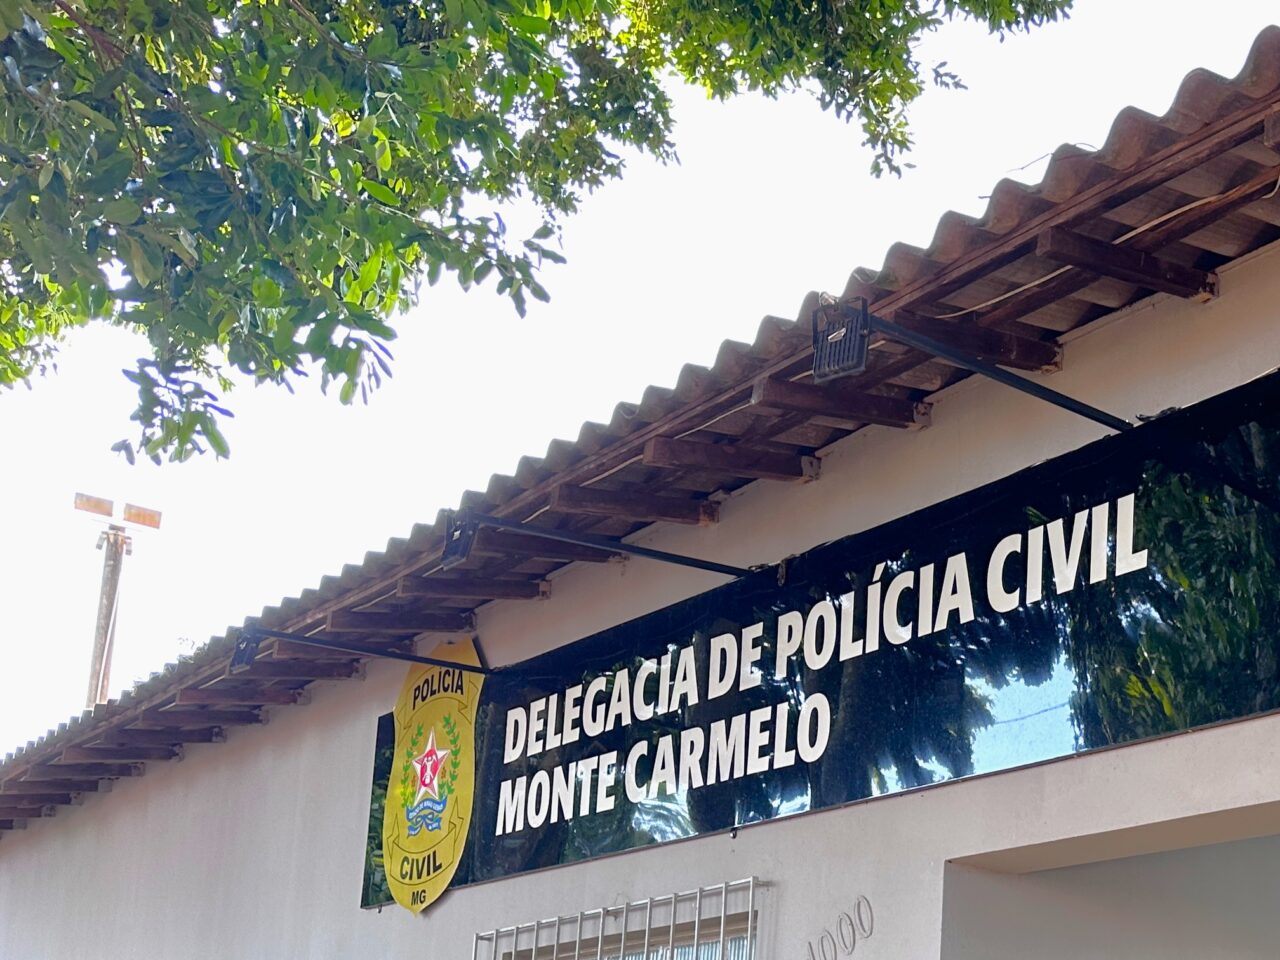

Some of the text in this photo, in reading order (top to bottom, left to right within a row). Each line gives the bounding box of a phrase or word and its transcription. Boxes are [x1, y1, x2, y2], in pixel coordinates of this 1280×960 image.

[504, 493, 1148, 765] DELEGACIA DE POLÍCIA CIVIL
[412, 667, 464, 711] POLÍCIA
[495, 693, 831, 836] MONTE CARMELO
[400, 850, 443, 881] CIVIL
[411, 889, 427, 906] MG
